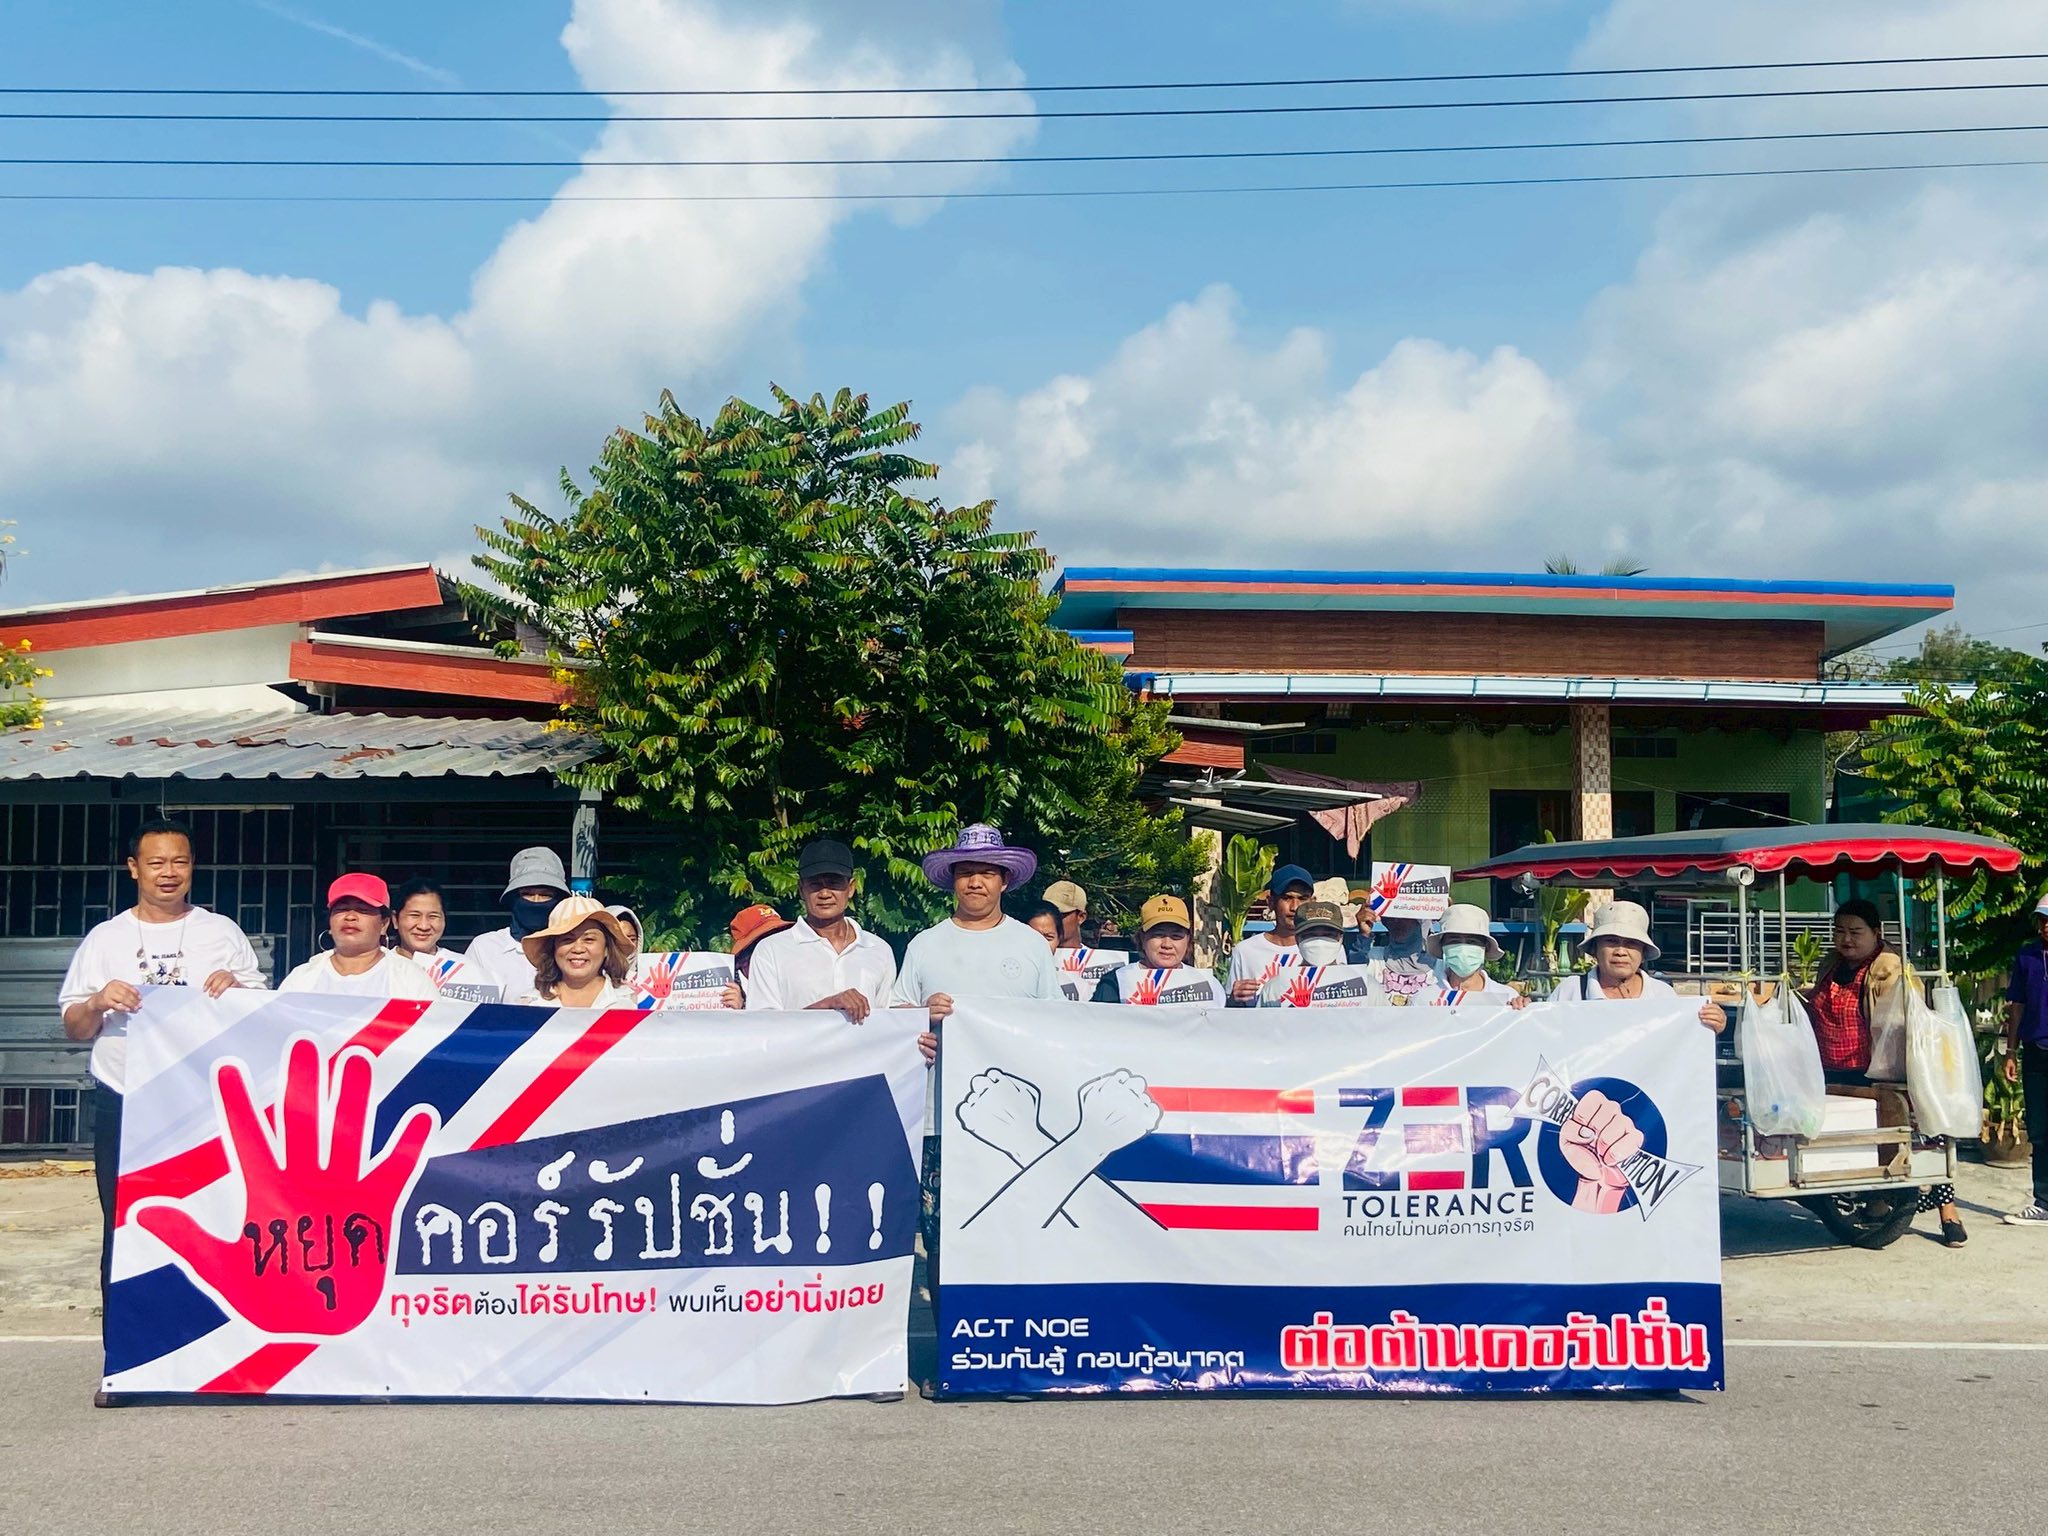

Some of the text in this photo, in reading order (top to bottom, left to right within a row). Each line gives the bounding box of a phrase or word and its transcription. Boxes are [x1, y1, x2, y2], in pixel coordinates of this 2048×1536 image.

[1338, 1077, 1668, 1214] ZERO
[1342, 1191, 1535, 1218] TOLERANCE
[1343, 1218, 1535, 1237] คนไทยไม่ทนต่อการทุจริต
[243, 1212, 386, 1311] หยุด
[668, 1272, 885, 1313] พบเห็นอย่านิ่งเฉย
[951, 1317, 1090, 1339] ACT NOE
[1280, 1296, 1710, 1372] ต่อต้านคอรัปชั่น
[951, 1343, 1245, 1376] ร่วมกันสู้ กอบกู้อนาคต
